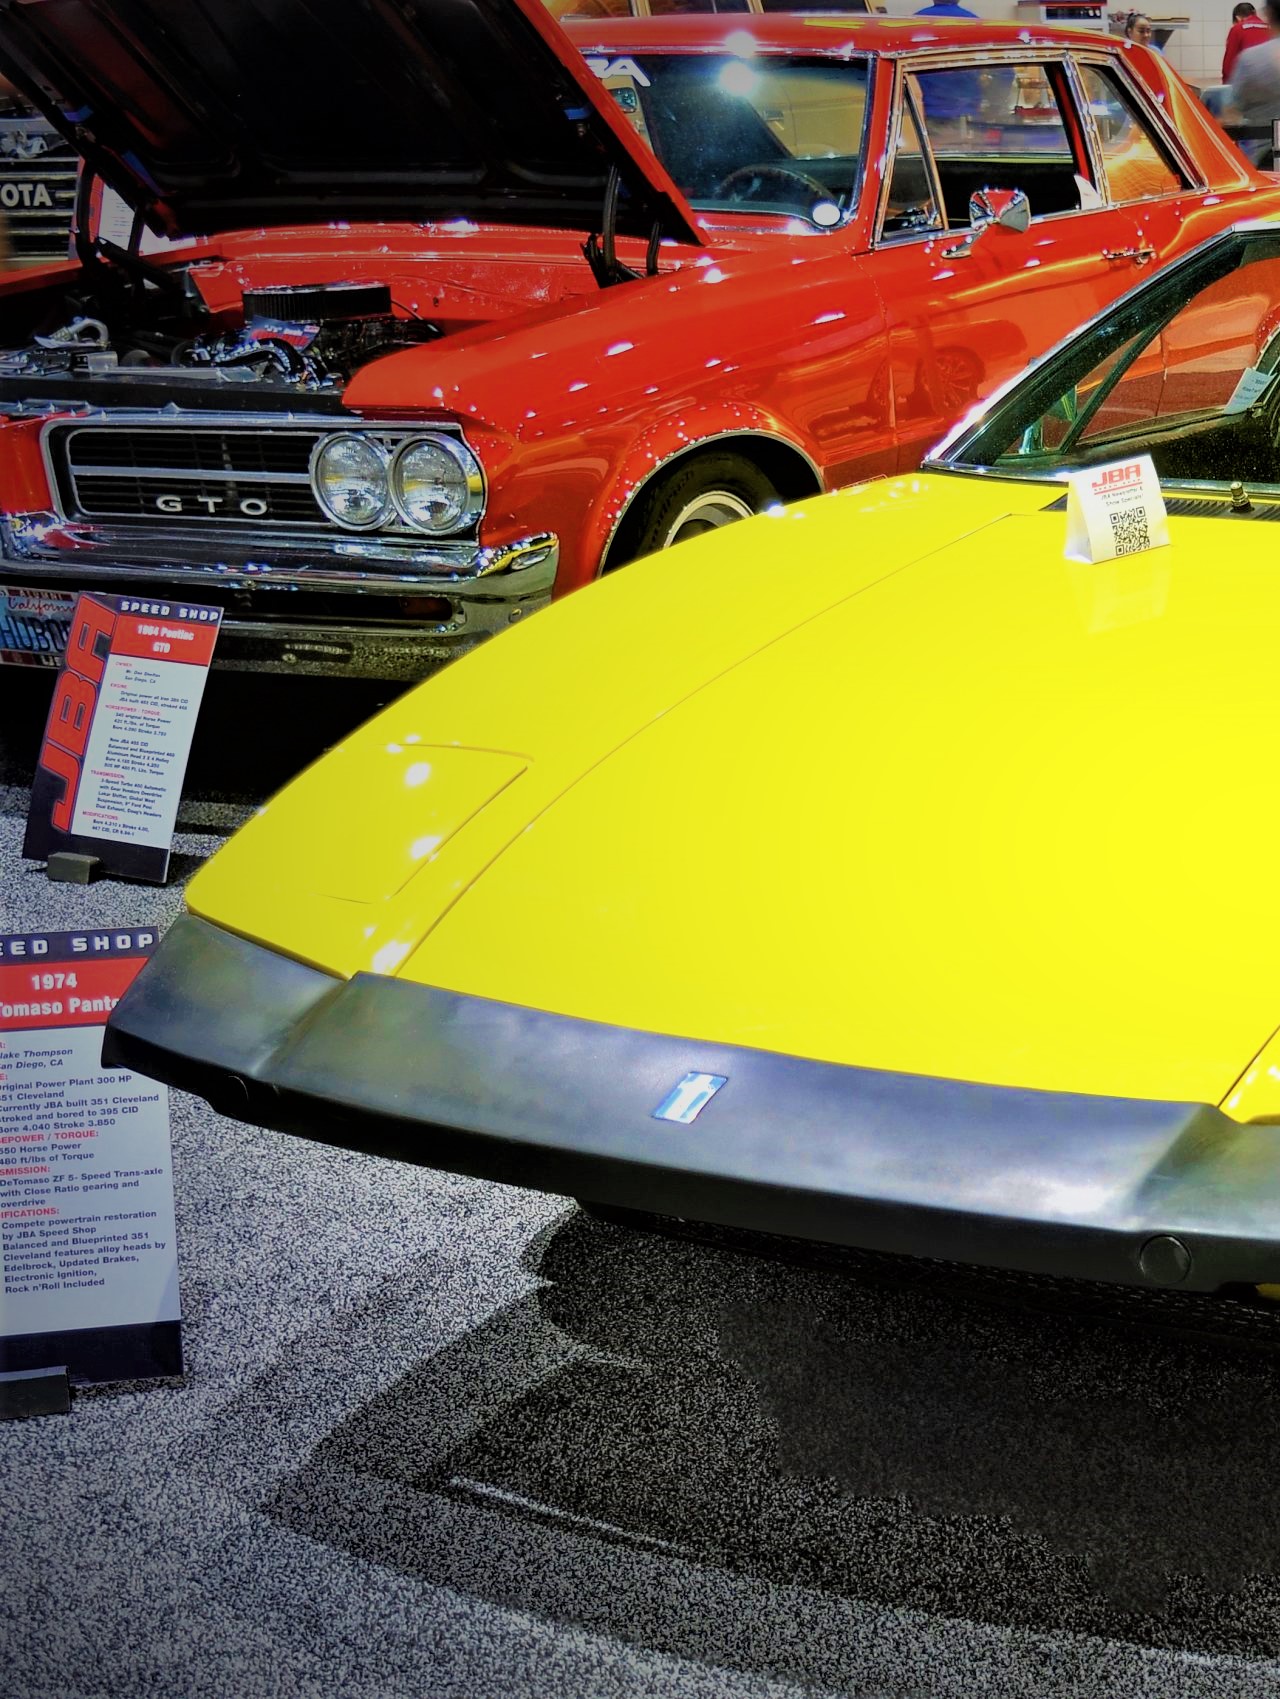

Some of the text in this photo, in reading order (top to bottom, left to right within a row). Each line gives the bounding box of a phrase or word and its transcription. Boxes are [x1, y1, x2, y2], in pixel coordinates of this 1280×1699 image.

[0, 183, 52, 207] OTA
[1092, 464, 1141, 488] JBA
[156, 494, 268, 516] GTO
[121, 600, 219, 622] SPEED SHOP
[160, 628, 194, 640] Pontiac
[152, 642, 171, 654] GTO
[41, 594, 118, 833] JBA
[72, 933, 154, 952] SHOP
[32, 972, 78, 990] 1974
[0, 1001, 62, 1018] omaso
[24, 1049, 73, 1057] Thompson
[16, 1061, 46, 1069] Diego,
[69, 1078, 94, 1086] Plant
[17, 1090, 64, 1100] Cleveland
[44, 1101, 63, 1109] JBA
[66, 1099, 88, 1107] built
[112, 1094, 159, 1104] Cleveland
[57, 1110, 84, 1118] bored
[22, 1123, 50, 1131] 4.040
[54, 1121, 85, 1129] Stroke
[88, 1118, 116, 1127] 3.850
[0, 1134, 44, 1144] EPOWER
[54, 1130, 98, 1140] TORQUE:
[20, 1156, 46, 1164] ft/lbs
[61, 1153, 94, 1162] Torque
[0, 1178, 50, 1186] DeTomaso
[81, 1171, 111, 1181] Speed
[114, 1168, 163, 1178] Trans-axle
[0, 1189, 21, 1197] with
[54, 1185, 80, 1193] Ratio
[82, 1182, 118, 1192] gearing
[122, 1180, 139, 1188] and
[0, 1198, 46, 1208] overdrive
[0, 1208, 59, 1219] IFICATIONS:
[1, 1211, 156, 1229] Compete powertrain restoration
[2, 1233, 14, 1241] by
[16, 1231, 36, 1239] JBA
[39, 1228, 69, 1238] Speed
[3, 1240, 48, 1251] Balanced
[51, 1238, 68, 1246] and
[72, 1233, 128, 1245] Blueprinted
[3, 1250, 51, 1261] Cleveland
[54, 1249, 94, 1257] features
[123, 1242, 152, 1251] heads
[155, 1241, 166, 1249] by
[4, 1255, 139, 1272] Edelbrock, Updated Brakes,
[5, 1269, 97, 1283] Electronic Ignition,
[5, 1278, 104, 1294] Rock n'Roll Included
